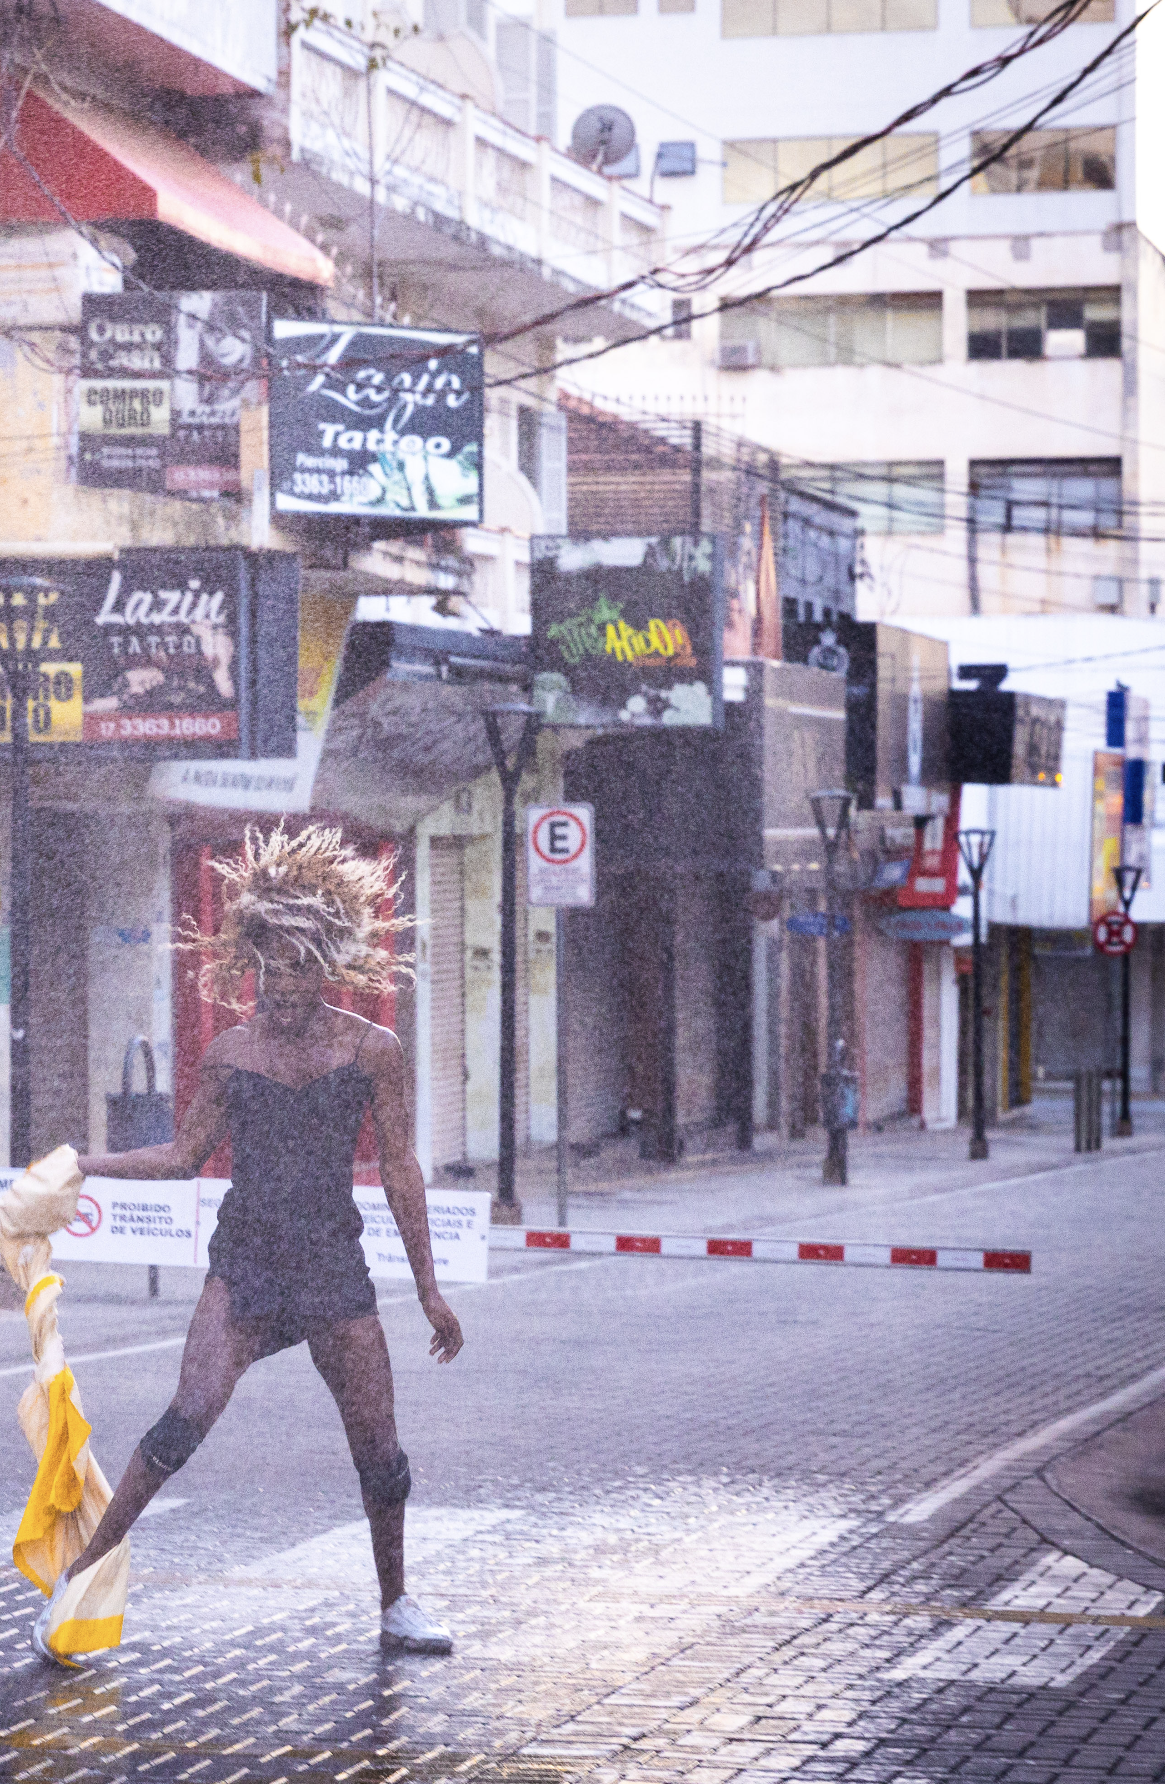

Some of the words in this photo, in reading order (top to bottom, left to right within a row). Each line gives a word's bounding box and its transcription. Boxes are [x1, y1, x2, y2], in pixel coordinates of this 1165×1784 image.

[86, 386, 164, 407] COMPRO
[317, 422, 452, 456] Tattoo
[94, 570, 226, 626] Lazin
[549, 821, 570, 854] E
[111, 1201, 171, 1213] PROIBIDO
[427, 1205, 477, 1217] ERIADOS
[110, 1225, 126, 1236] DE
